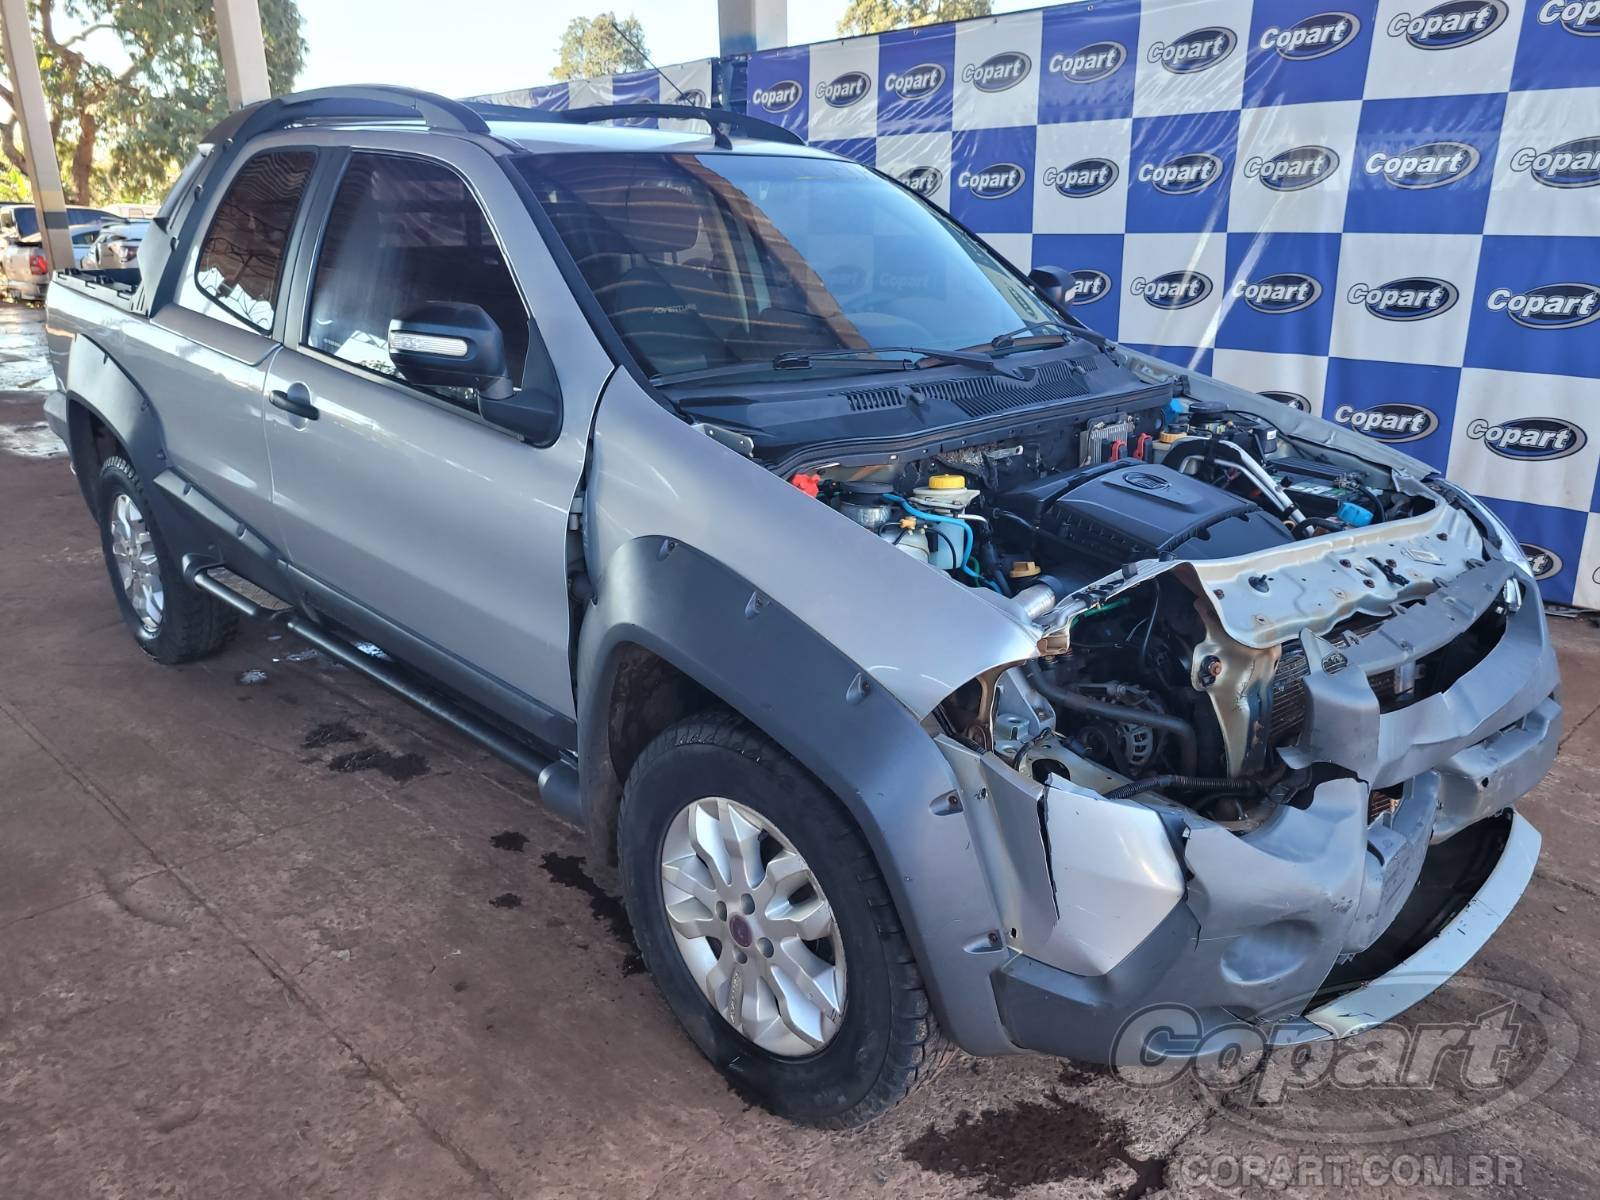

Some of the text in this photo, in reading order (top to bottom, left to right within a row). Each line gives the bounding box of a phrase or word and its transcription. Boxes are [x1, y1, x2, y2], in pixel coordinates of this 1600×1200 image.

[1260, 18, 1348, 50] Copart
[1387, 5, 1490, 41] Copart
[1049, 47, 1120, 79] Copart
[1147, 33, 1226, 66] Copart
[885, 68, 940, 97] Copart
[962, 57, 1028, 89] Copart
[752, 85, 798, 106] Copart
[815, 77, 867, 103] Copart
[1043, 161, 1111, 189] Copart
[1138, 157, 1215, 184] Copart
[1244, 152, 1329, 184] Copart
[1365, 147, 1464, 179] Copart
[958, 167, 1018, 191] Copart
[1130, 276, 1201, 300] Copart
[1232, 278, 1310, 305] Copart
[1347, 281, 1445, 311] Copart
[1487, 288, 1595, 317] Copart
[1335, 405, 1426, 434] Copart
[1466, 419, 1575, 450] Copart
